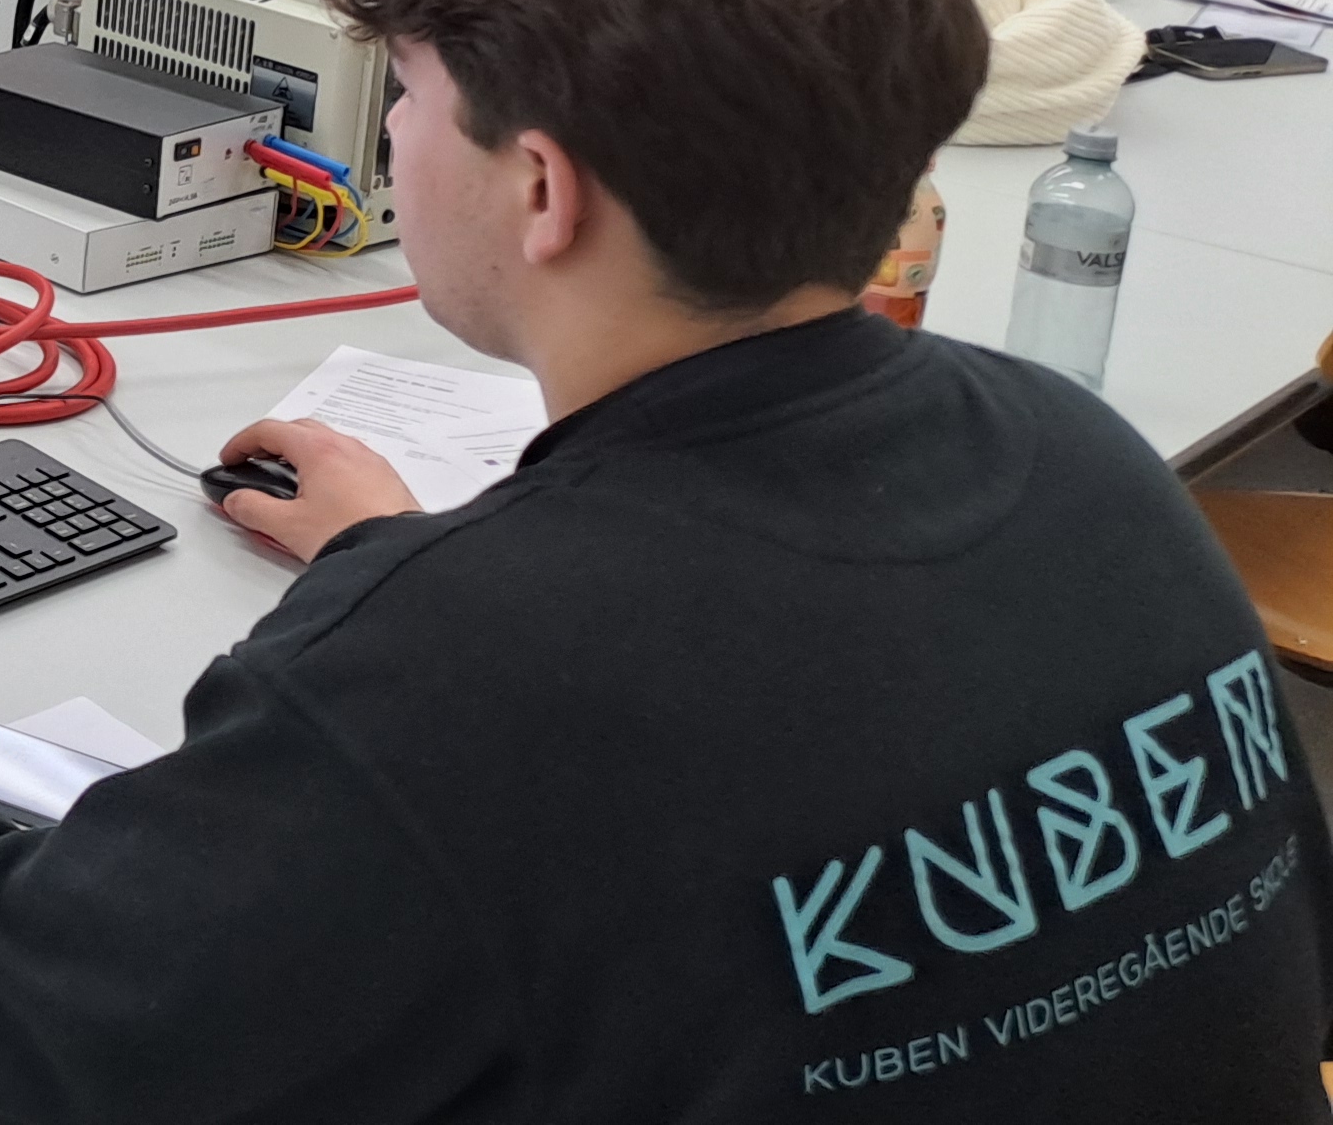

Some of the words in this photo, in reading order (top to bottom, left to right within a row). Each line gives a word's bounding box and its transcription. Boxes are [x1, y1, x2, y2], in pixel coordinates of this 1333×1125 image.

[771, 649, 1289, 1016] KUBEN
[802, 1025, 970, 1095] KUBEN
[984, 895, 1251, 1050] VIDEREGÅENDE
